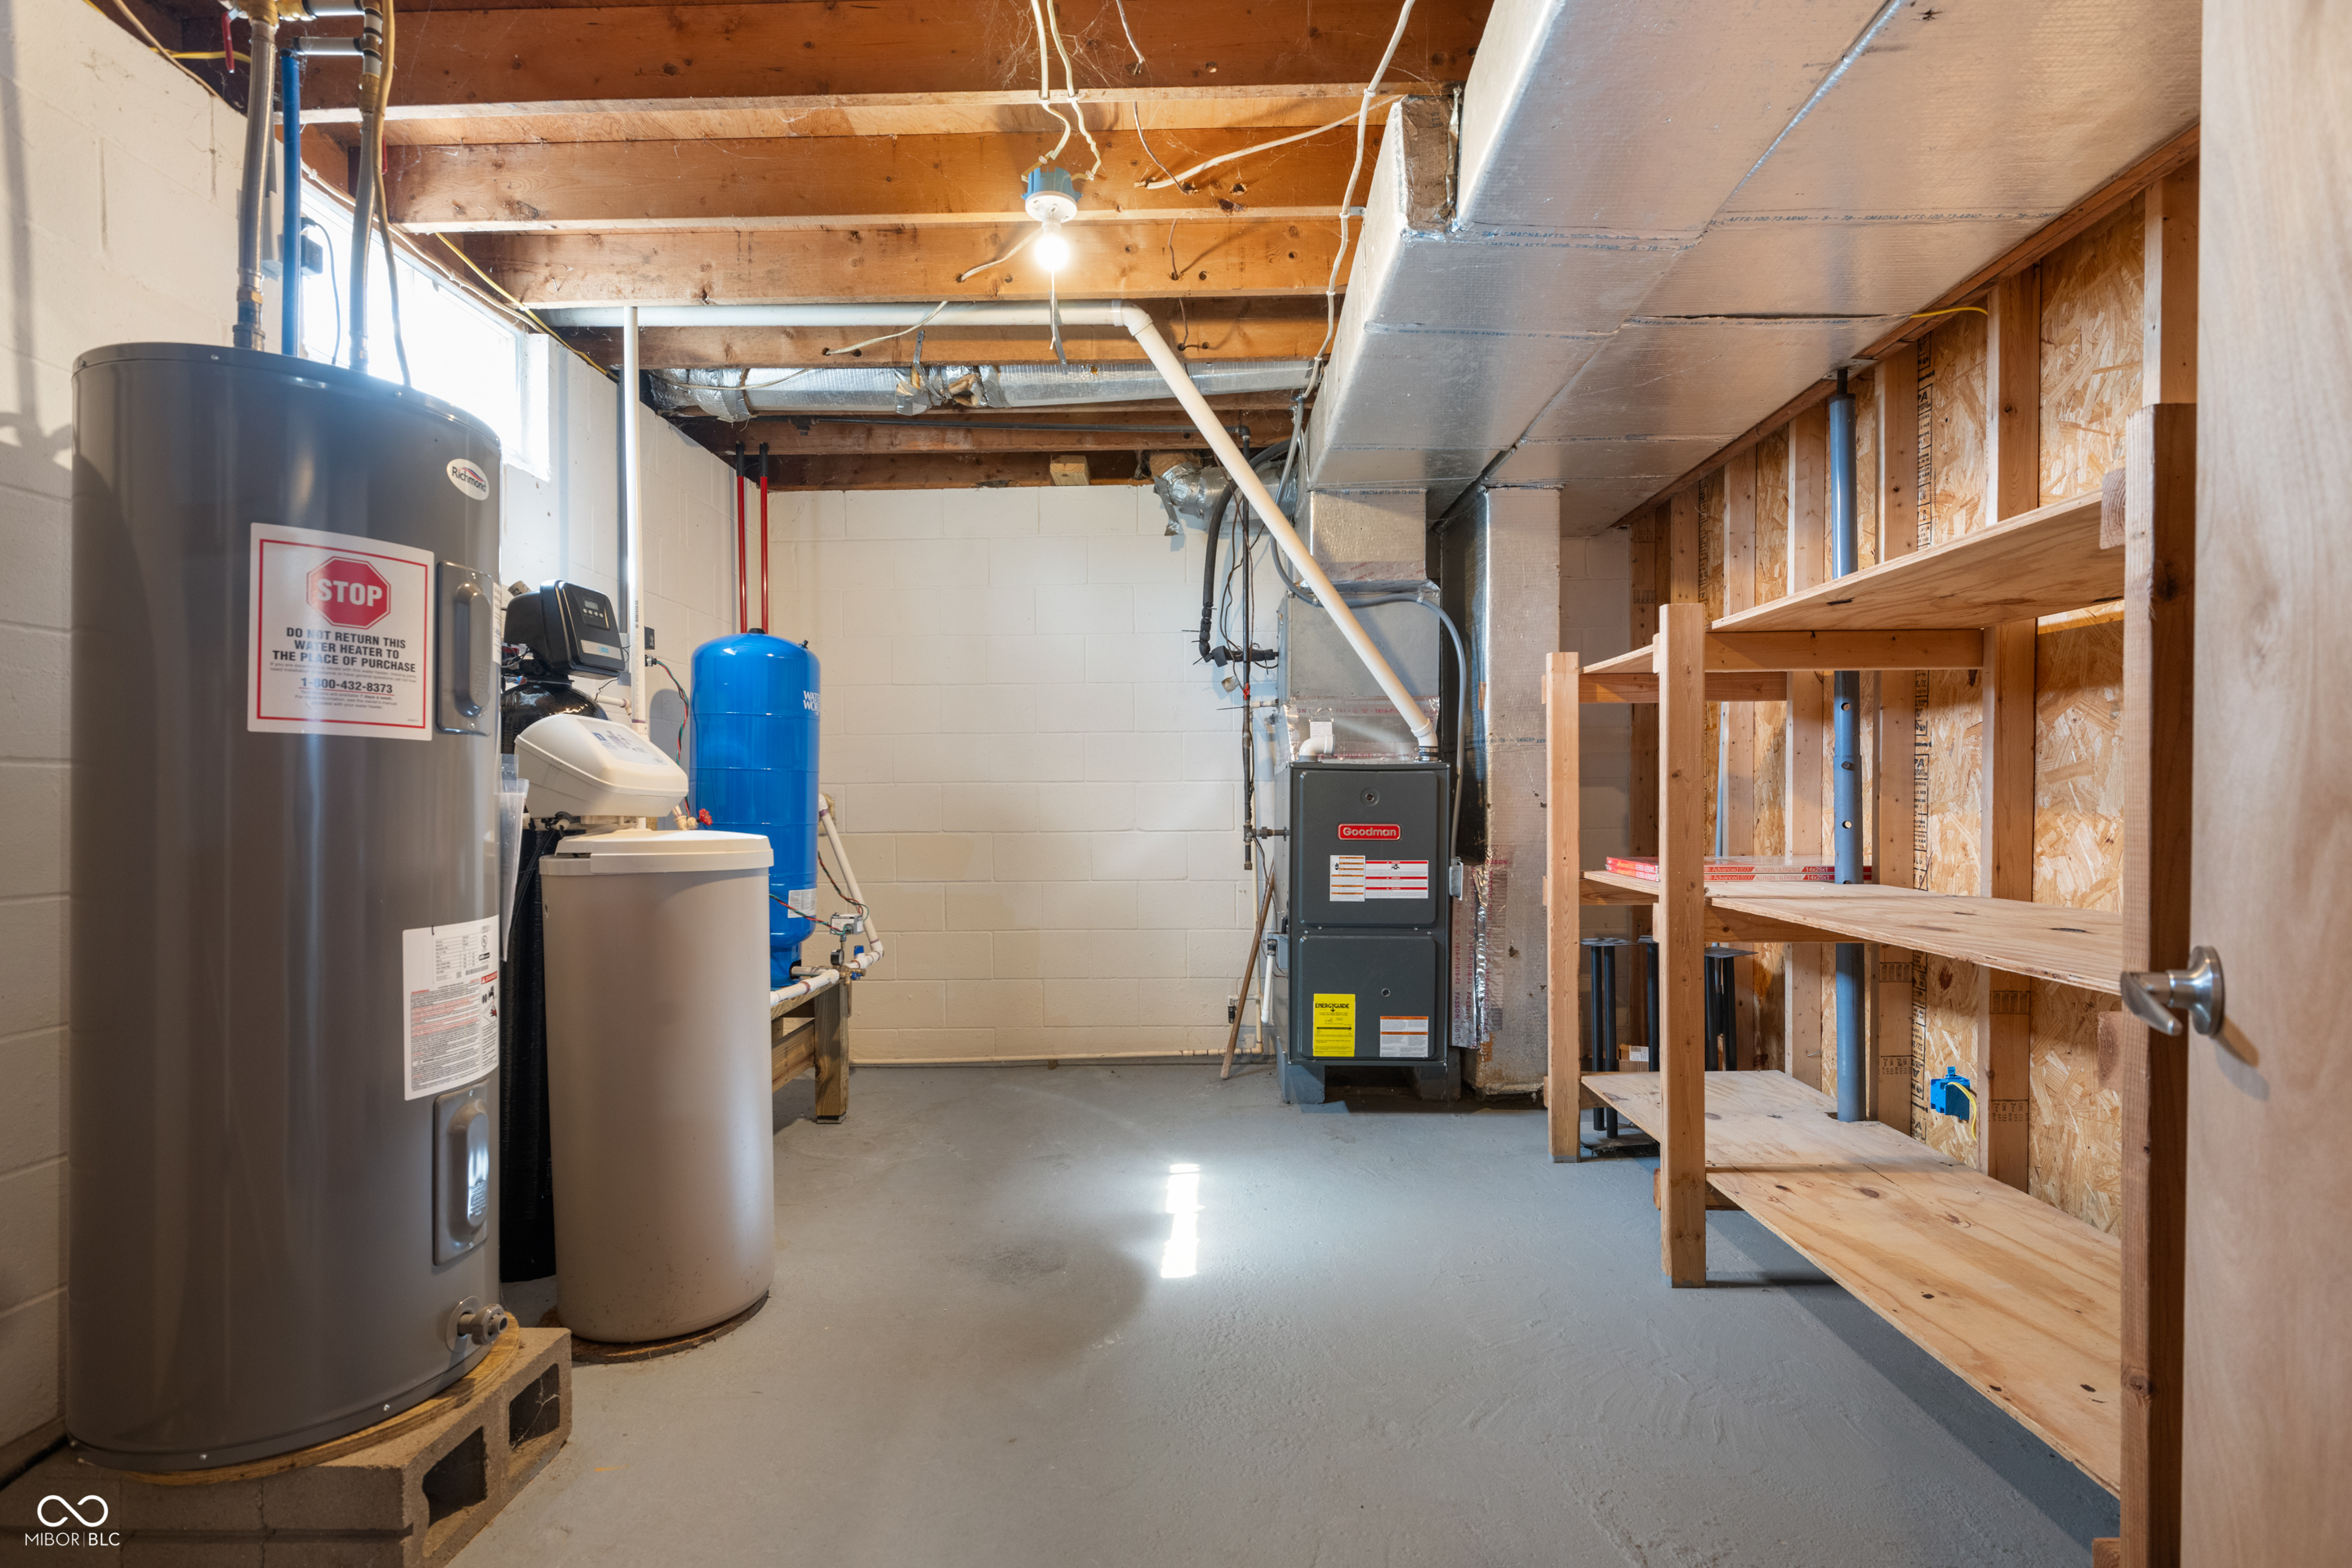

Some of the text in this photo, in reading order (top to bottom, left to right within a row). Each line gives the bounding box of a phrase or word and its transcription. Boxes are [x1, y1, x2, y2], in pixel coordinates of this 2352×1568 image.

[452, 466, 486, 492] Richmond
[317, 578, 383, 608] STOP
[287, 627, 406, 649] DO NOT RETURN THIS
[294, 639, 399, 659] WATER HEATER TO
[273, 650, 416, 672] THE PLACE OF PURCHASE
[301, 677, 393, 693] 1-800-432-8373
[1343, 827, 1396, 836] Goodman
